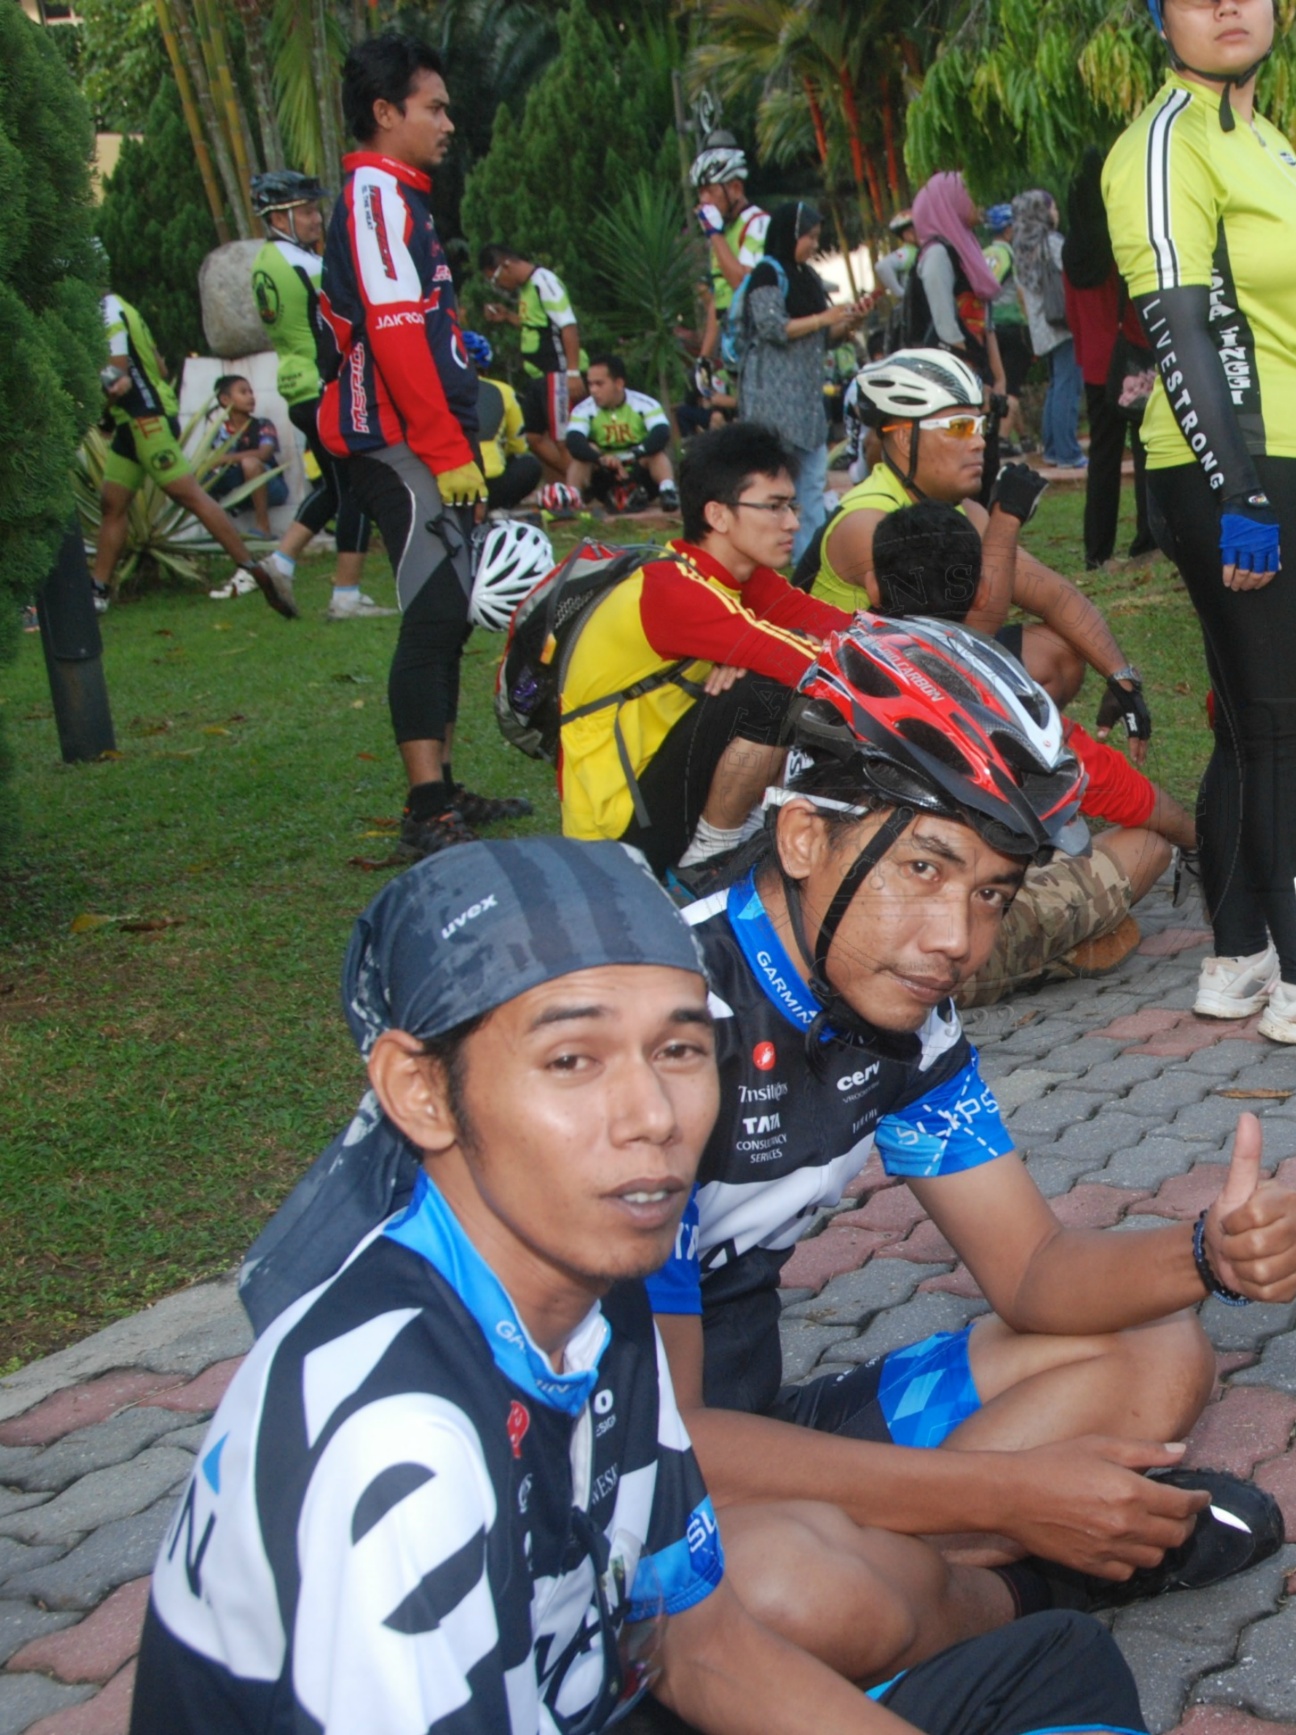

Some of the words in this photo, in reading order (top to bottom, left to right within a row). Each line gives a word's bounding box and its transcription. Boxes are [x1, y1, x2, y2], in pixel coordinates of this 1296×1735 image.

[1142, 298, 1225, 490] LIVESTRONG
[898, 661, 945, 702] CARBON
[441, 894, 498, 939] uvex
[756, 950, 816, 1025] GARMIN
[742, 1113, 780, 1135] TATA
